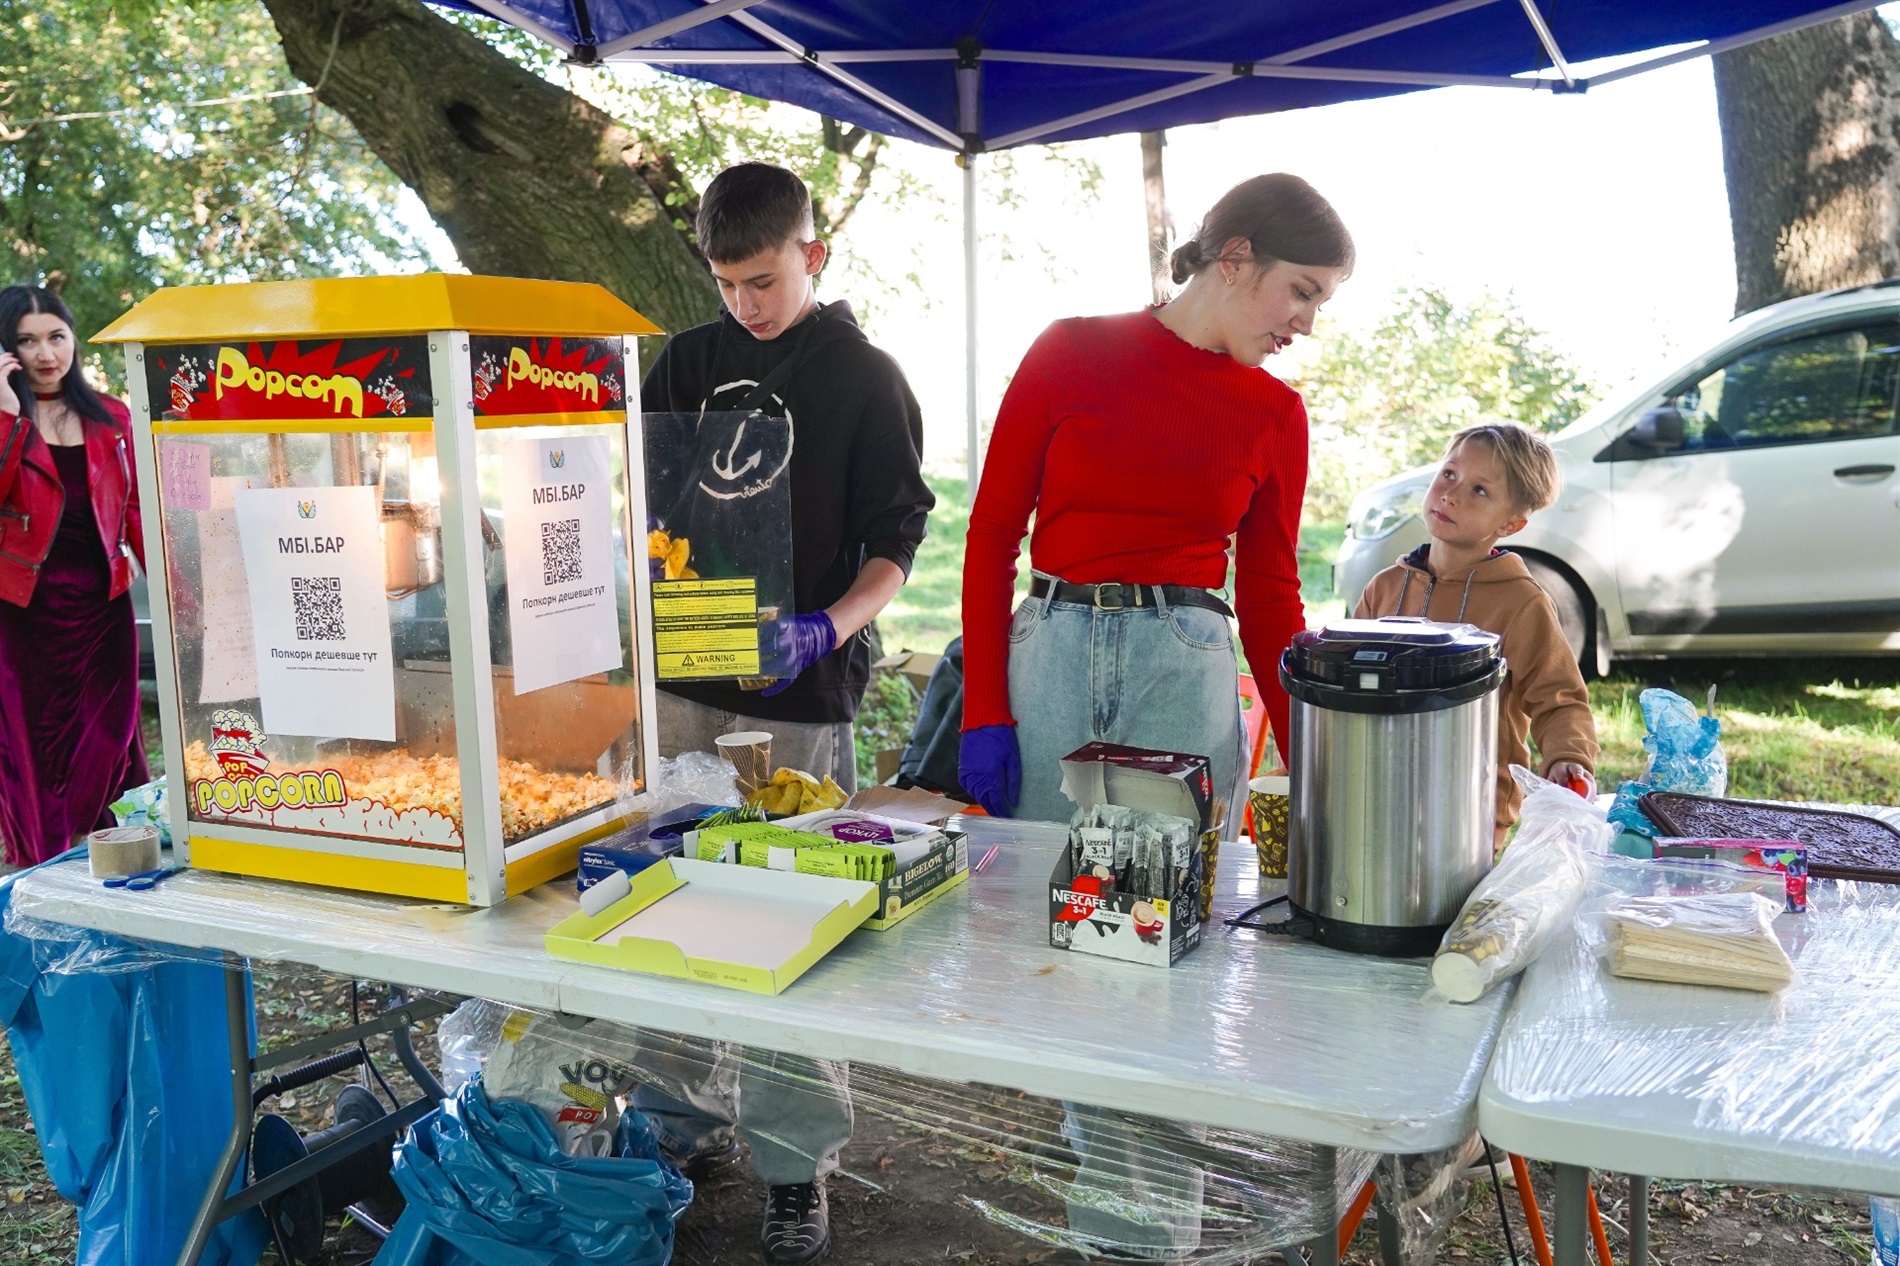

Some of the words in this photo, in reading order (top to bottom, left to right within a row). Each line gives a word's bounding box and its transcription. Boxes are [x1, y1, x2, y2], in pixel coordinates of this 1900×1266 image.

[216, 346, 363, 418] Popcorn
[507, 346, 598, 404] Popcorn
[532, 483, 585, 504] МБІ.БАР
[278, 536, 345, 554] МБІ.БАР
[522, 594, 557, 609] Попкорн
[558, 587, 593, 604] дешевше
[594, 585, 605, 596] тут
[271, 648, 313, 660] Попкорн
[315, 651, 360, 661] дешевше
[362, 652, 377, 663] тут
[696, 654, 736, 663] WARNING
[224, 761, 249, 772] POP
[197, 772, 344, 812] POPCORN
[904, 852, 943, 883] BIGELOW
